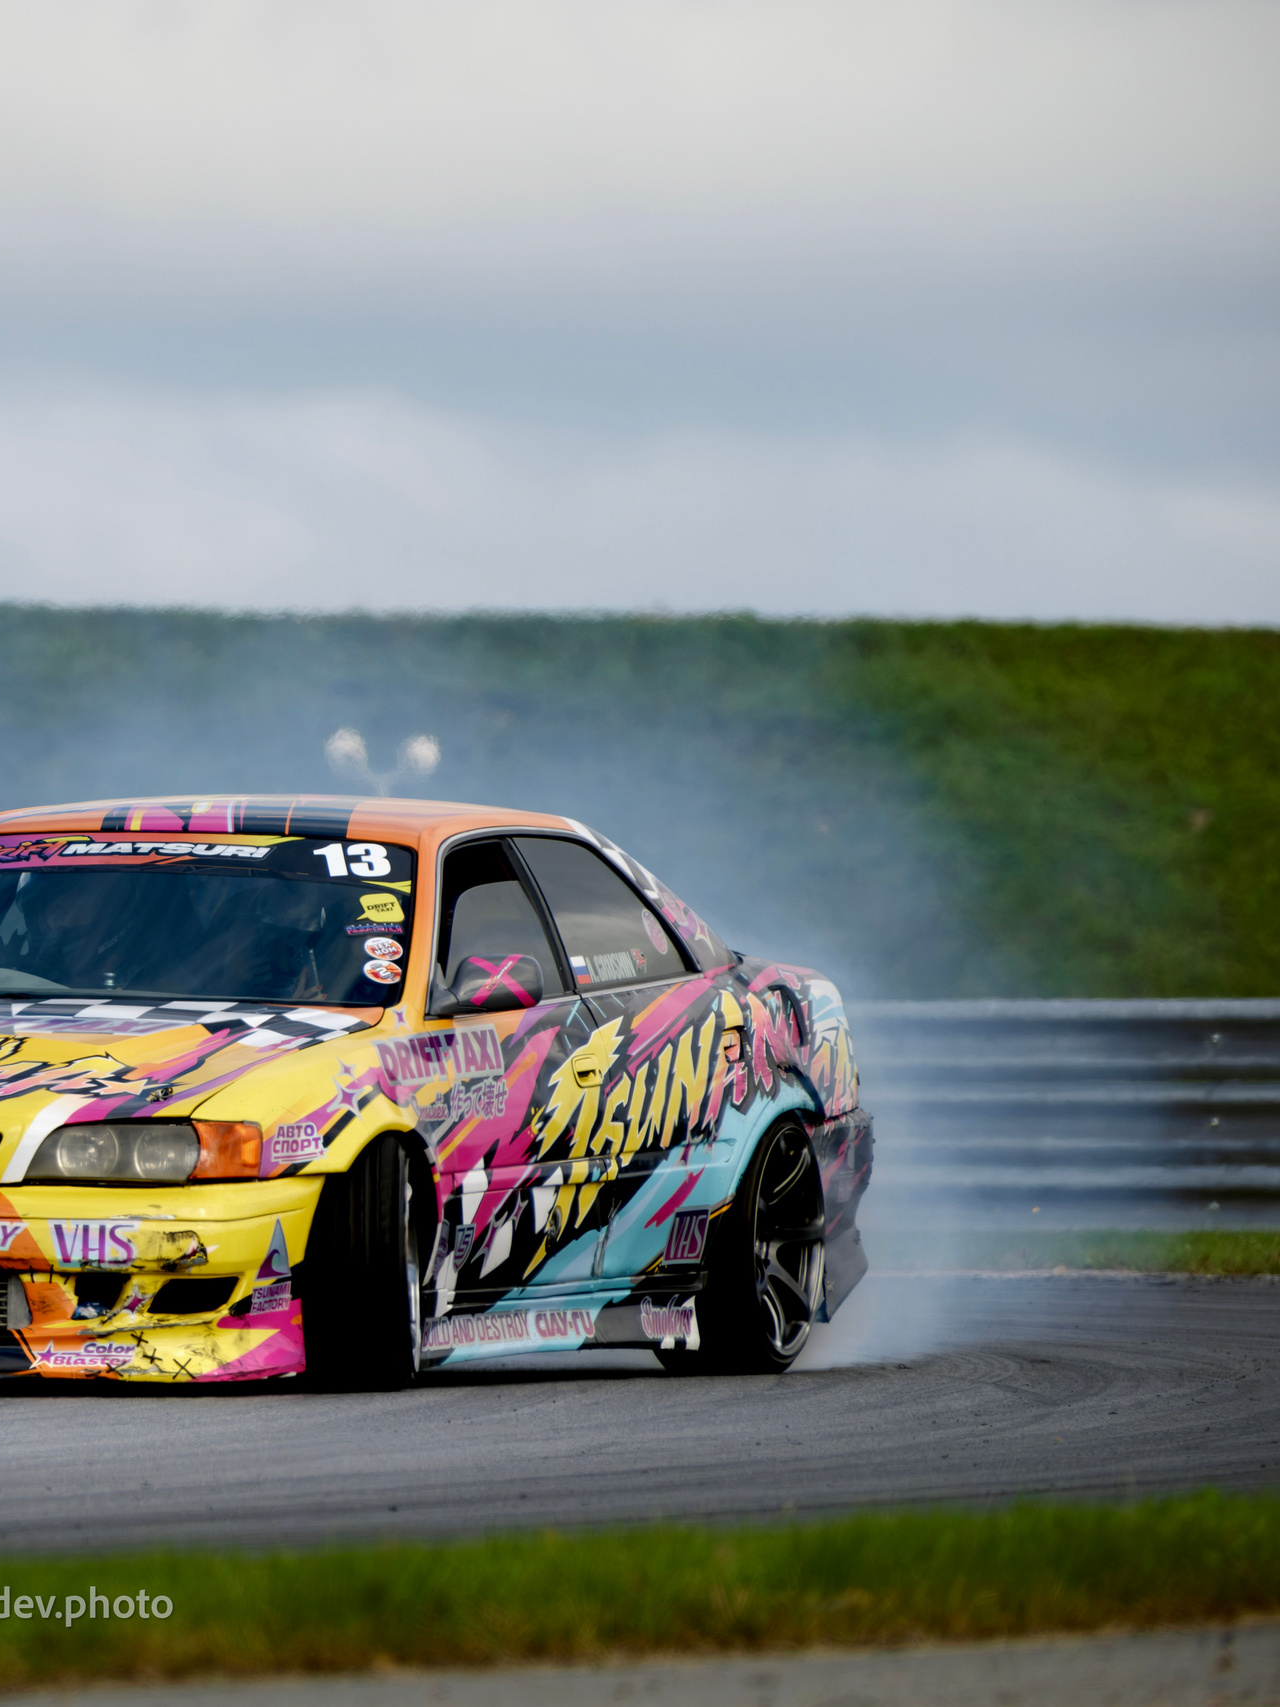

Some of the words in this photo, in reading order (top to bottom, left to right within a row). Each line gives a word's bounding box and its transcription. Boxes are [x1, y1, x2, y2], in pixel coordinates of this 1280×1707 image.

[62, 842, 268, 859] MATSURI
[313, 843, 391, 877] 13
[367, 901, 395, 911] DRIFT
[277, 1124, 315, 1138] АВТО
[273, 1136, 321, 1154] СПОРТ
[53, 1223, 136, 1264] VHS
[670, 1214, 707, 1259] VHS
[252, 1282, 290, 1301] TSUNAMI
[251, 1296, 290, 1315] FACTORY
[422, 1316, 450, 1348] BUILD
[452, 1314, 476, 1345] AND
[477, 1312, 530, 1341] DESTROY
[83, 1342, 137, 1354] Color
[53, 1354, 133, 1367] Blaster
